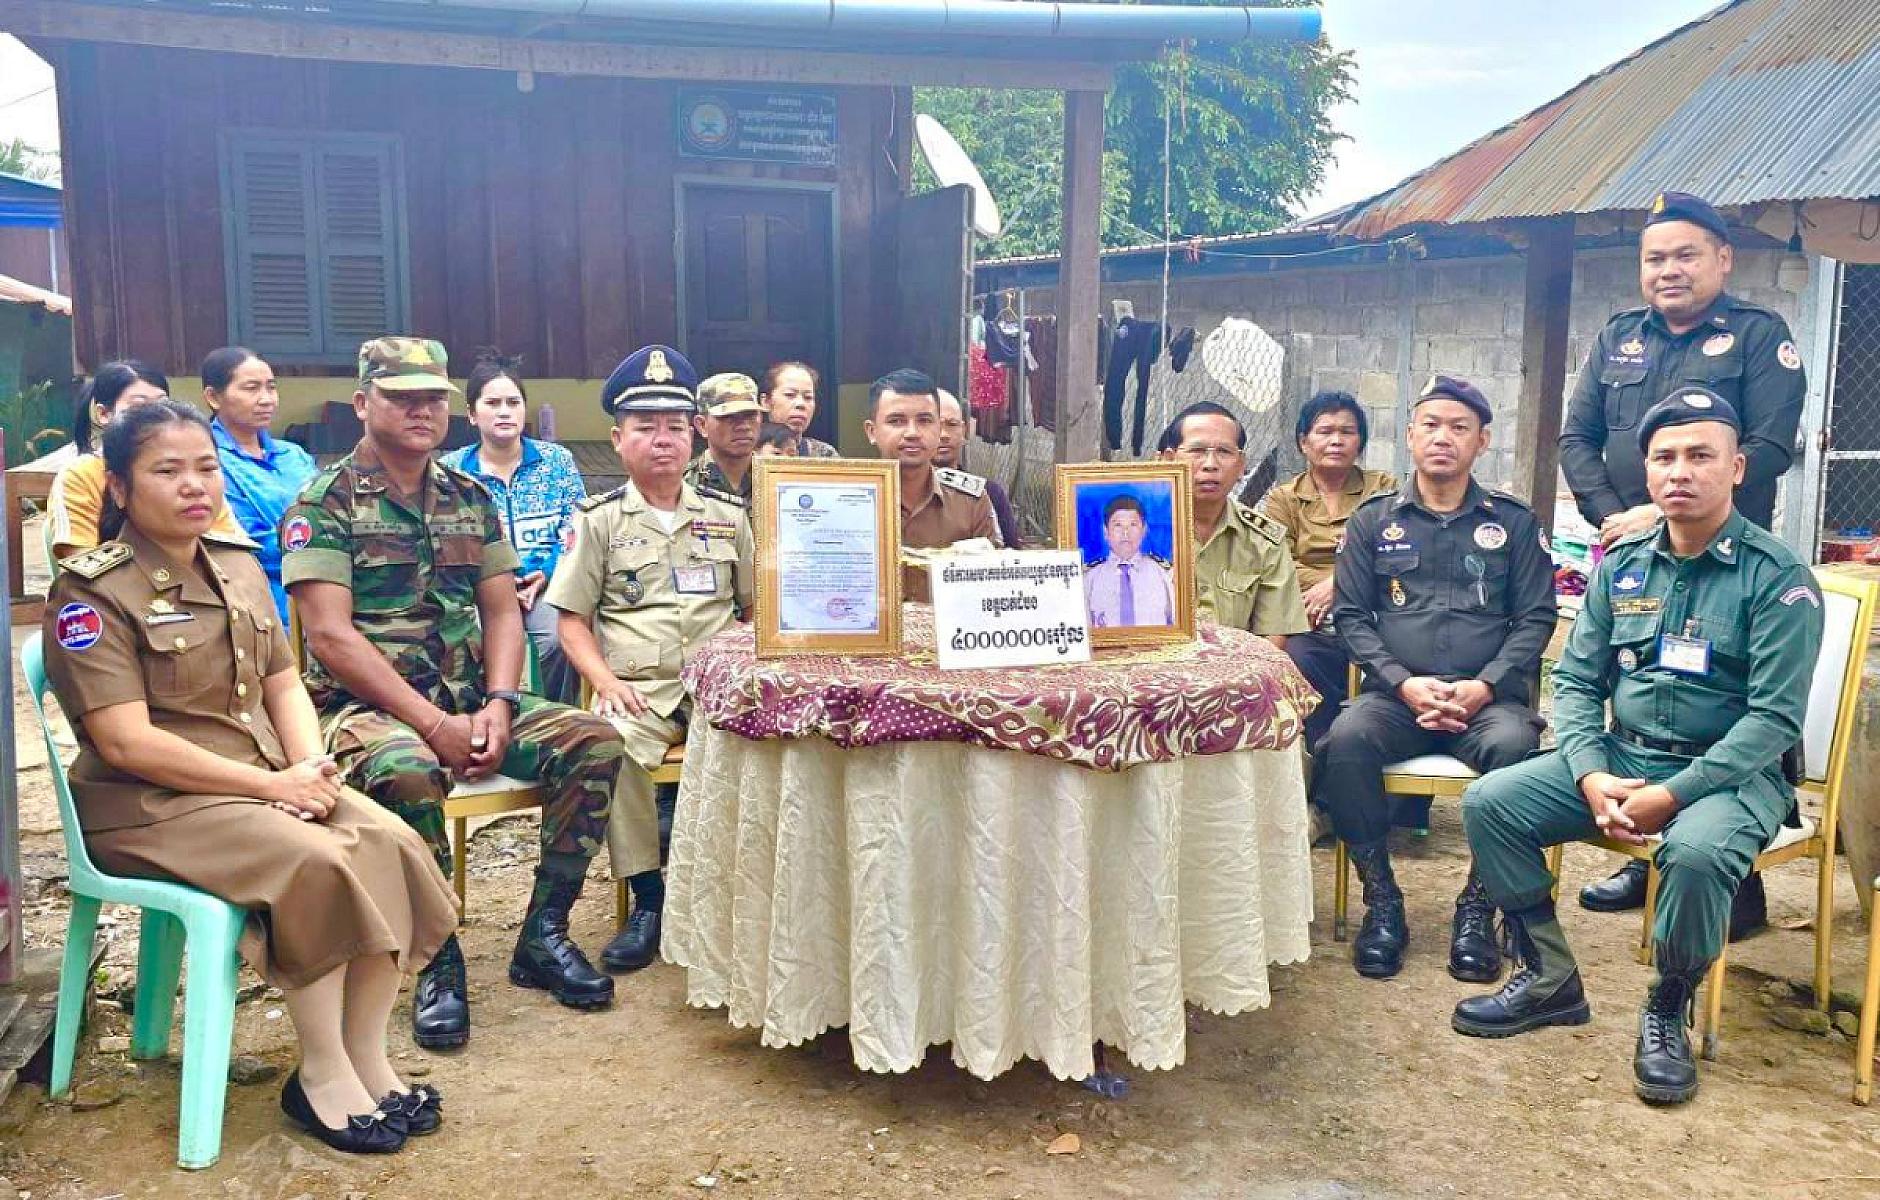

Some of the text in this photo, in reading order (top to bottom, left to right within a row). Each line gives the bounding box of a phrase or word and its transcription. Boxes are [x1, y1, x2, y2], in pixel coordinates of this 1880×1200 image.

[982, 590, 1038, 617] ខេត្តបាត់ដំបង
